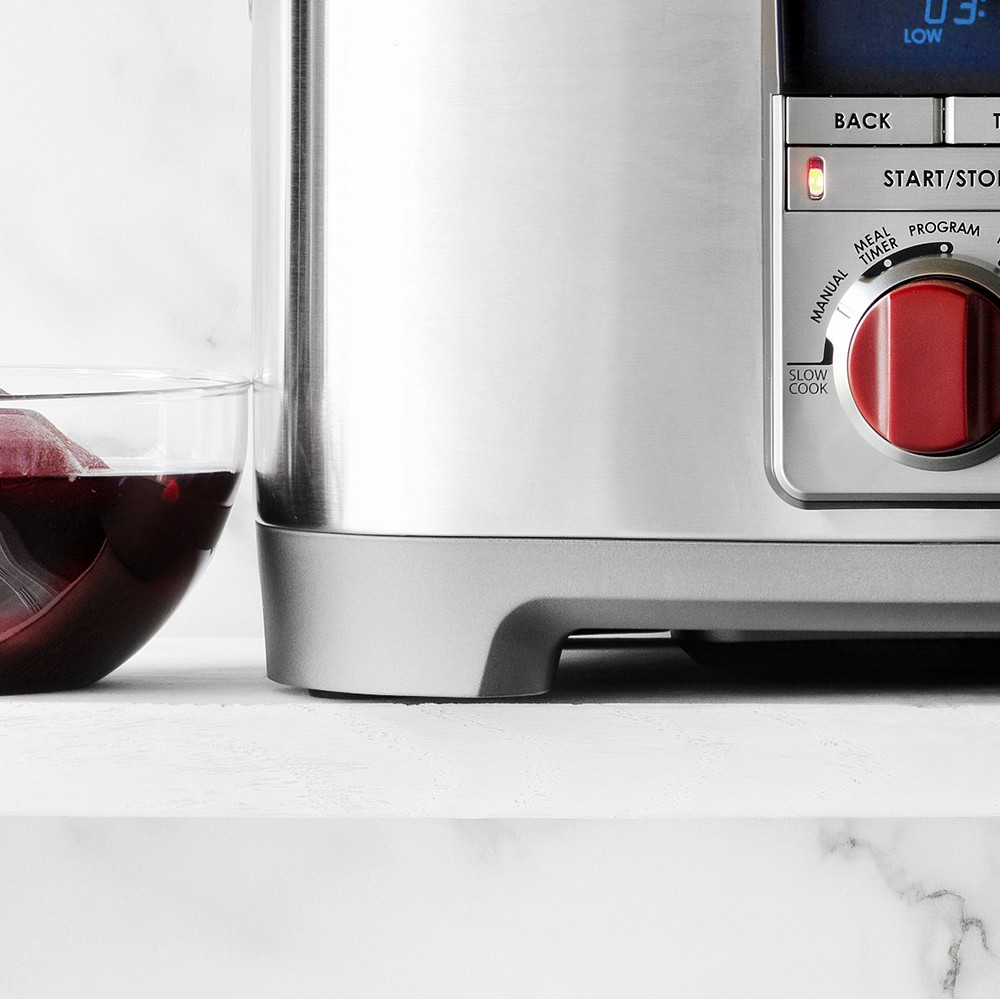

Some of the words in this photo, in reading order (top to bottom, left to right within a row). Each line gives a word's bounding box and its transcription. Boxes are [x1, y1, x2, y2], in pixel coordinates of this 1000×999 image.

[904, 28, 943, 44] LOW
[835, 112, 891, 129] BACK
[909, 221, 981, 237] PROGRAM
[854, 227, 891, 254] MEAL
[858, 237, 899, 265] TIMER
[810, 269, 849, 324] MANUAL
[789, 369, 828, 381] SLOW
[789, 383, 828, 395] COOK
